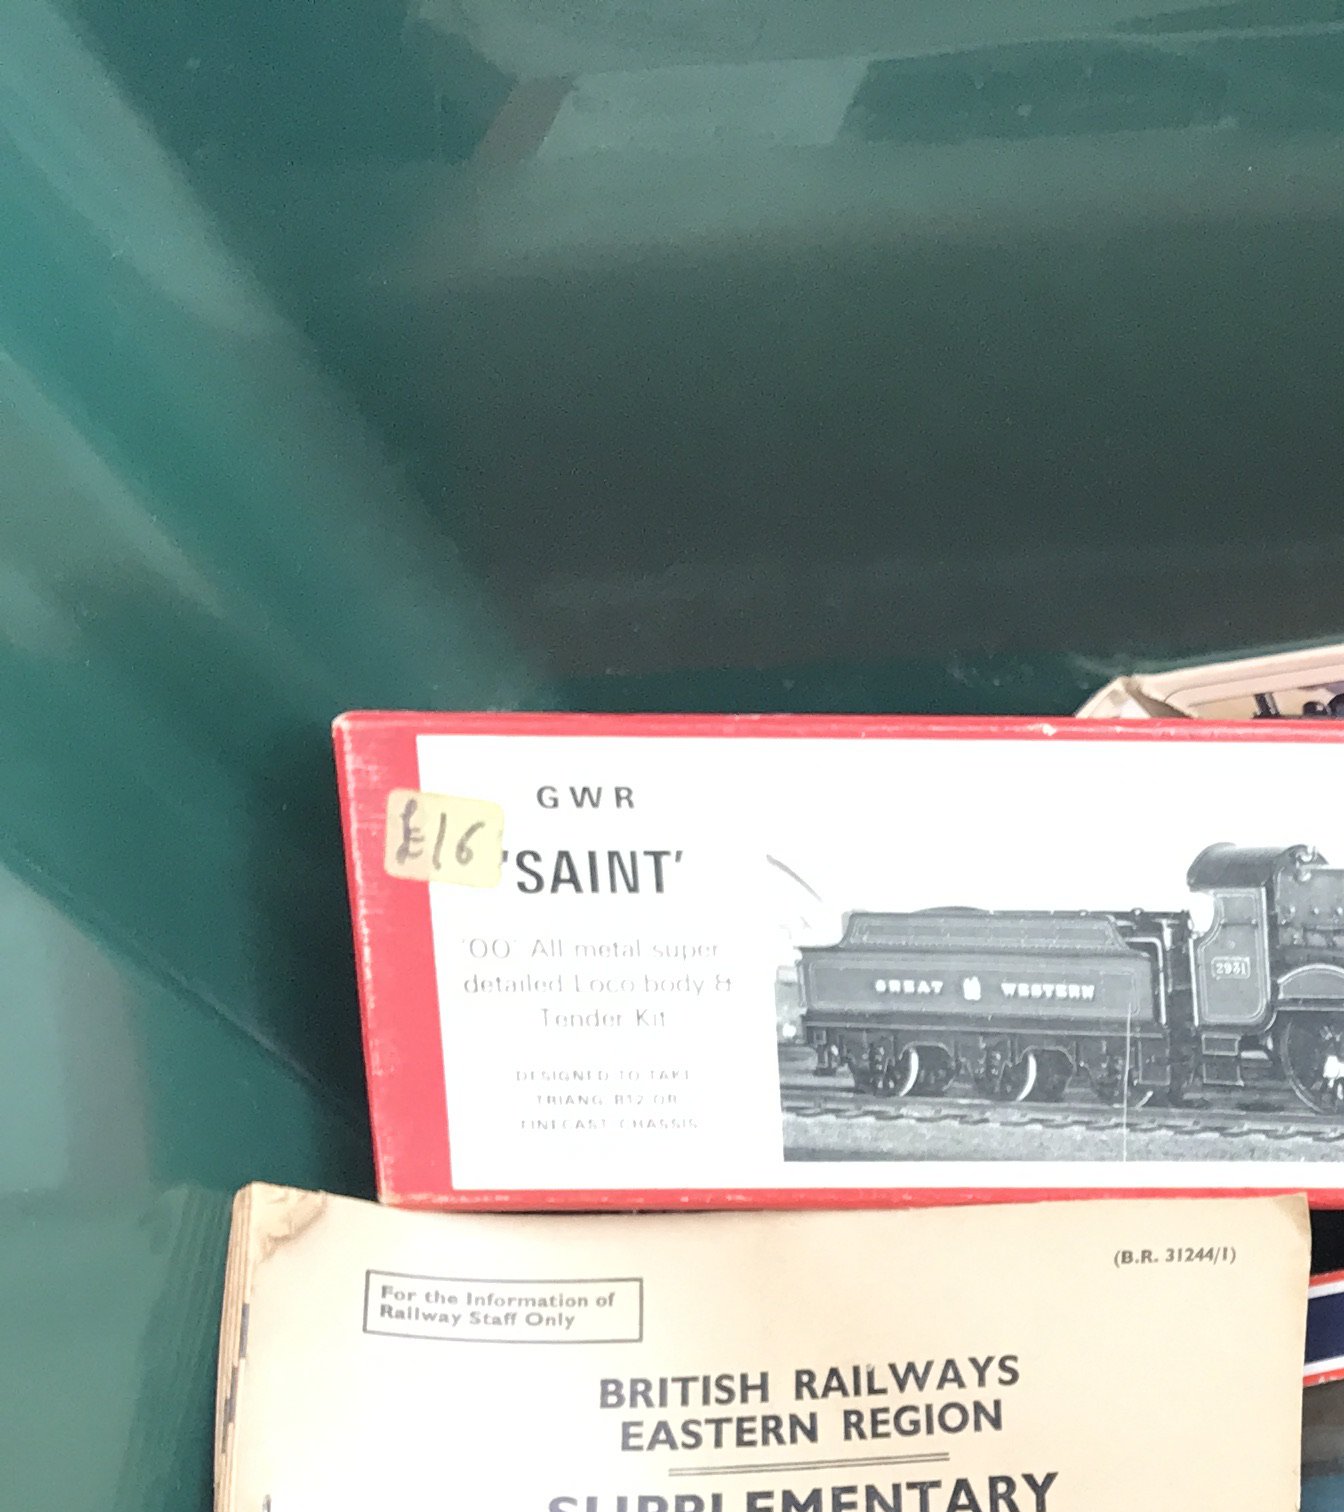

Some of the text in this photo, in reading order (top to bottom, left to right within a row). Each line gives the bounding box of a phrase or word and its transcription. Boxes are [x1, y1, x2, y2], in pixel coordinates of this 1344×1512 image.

[396, 798, 485, 870] £16
[531, 939, 562, 958] All
[576, 940, 640, 958] metal
[652, 944, 718, 961] super
[464, 974, 562, 993] detailed
[575, 974, 634, 993] Loco
[645, 974, 704, 997] body
[1001, 982, 1095, 1000] WESTERN
[541, 1009, 665, 1027] Tender Kit
[1114, 1247, 1235, 1267] (B.R. 31244/1)
[381, 1285, 614, 1307] For the Information of
[380, 1304, 574, 1329] Railway Staff Only
[600, 1354, 1018, 1408] BRITISH RAILWAYS
[621, 1399, 1001, 1450] EASTERN REGION
